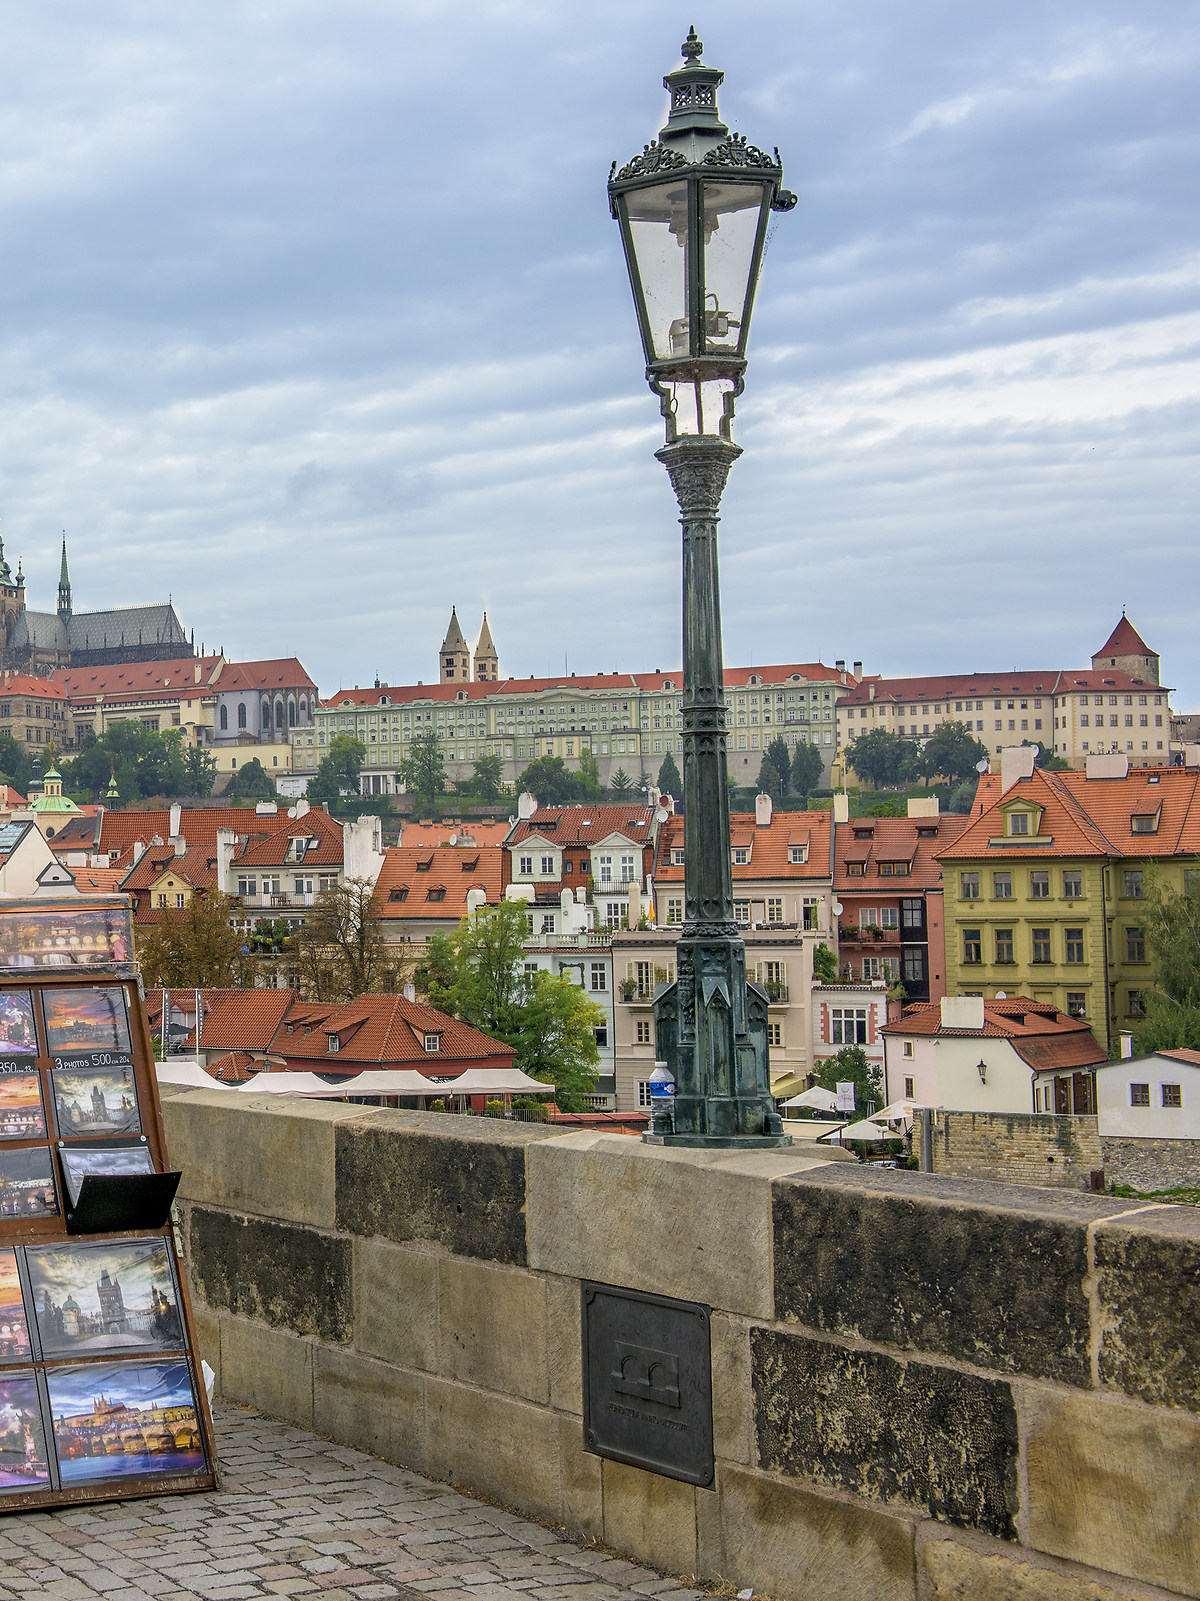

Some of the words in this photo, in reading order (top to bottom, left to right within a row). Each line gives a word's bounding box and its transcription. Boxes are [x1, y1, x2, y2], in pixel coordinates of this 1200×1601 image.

[54, 1057, 63, 1070] 3
[63, 1059, 90, 1070] PHOTOS
[91, 1053, 112, 1066] 500
